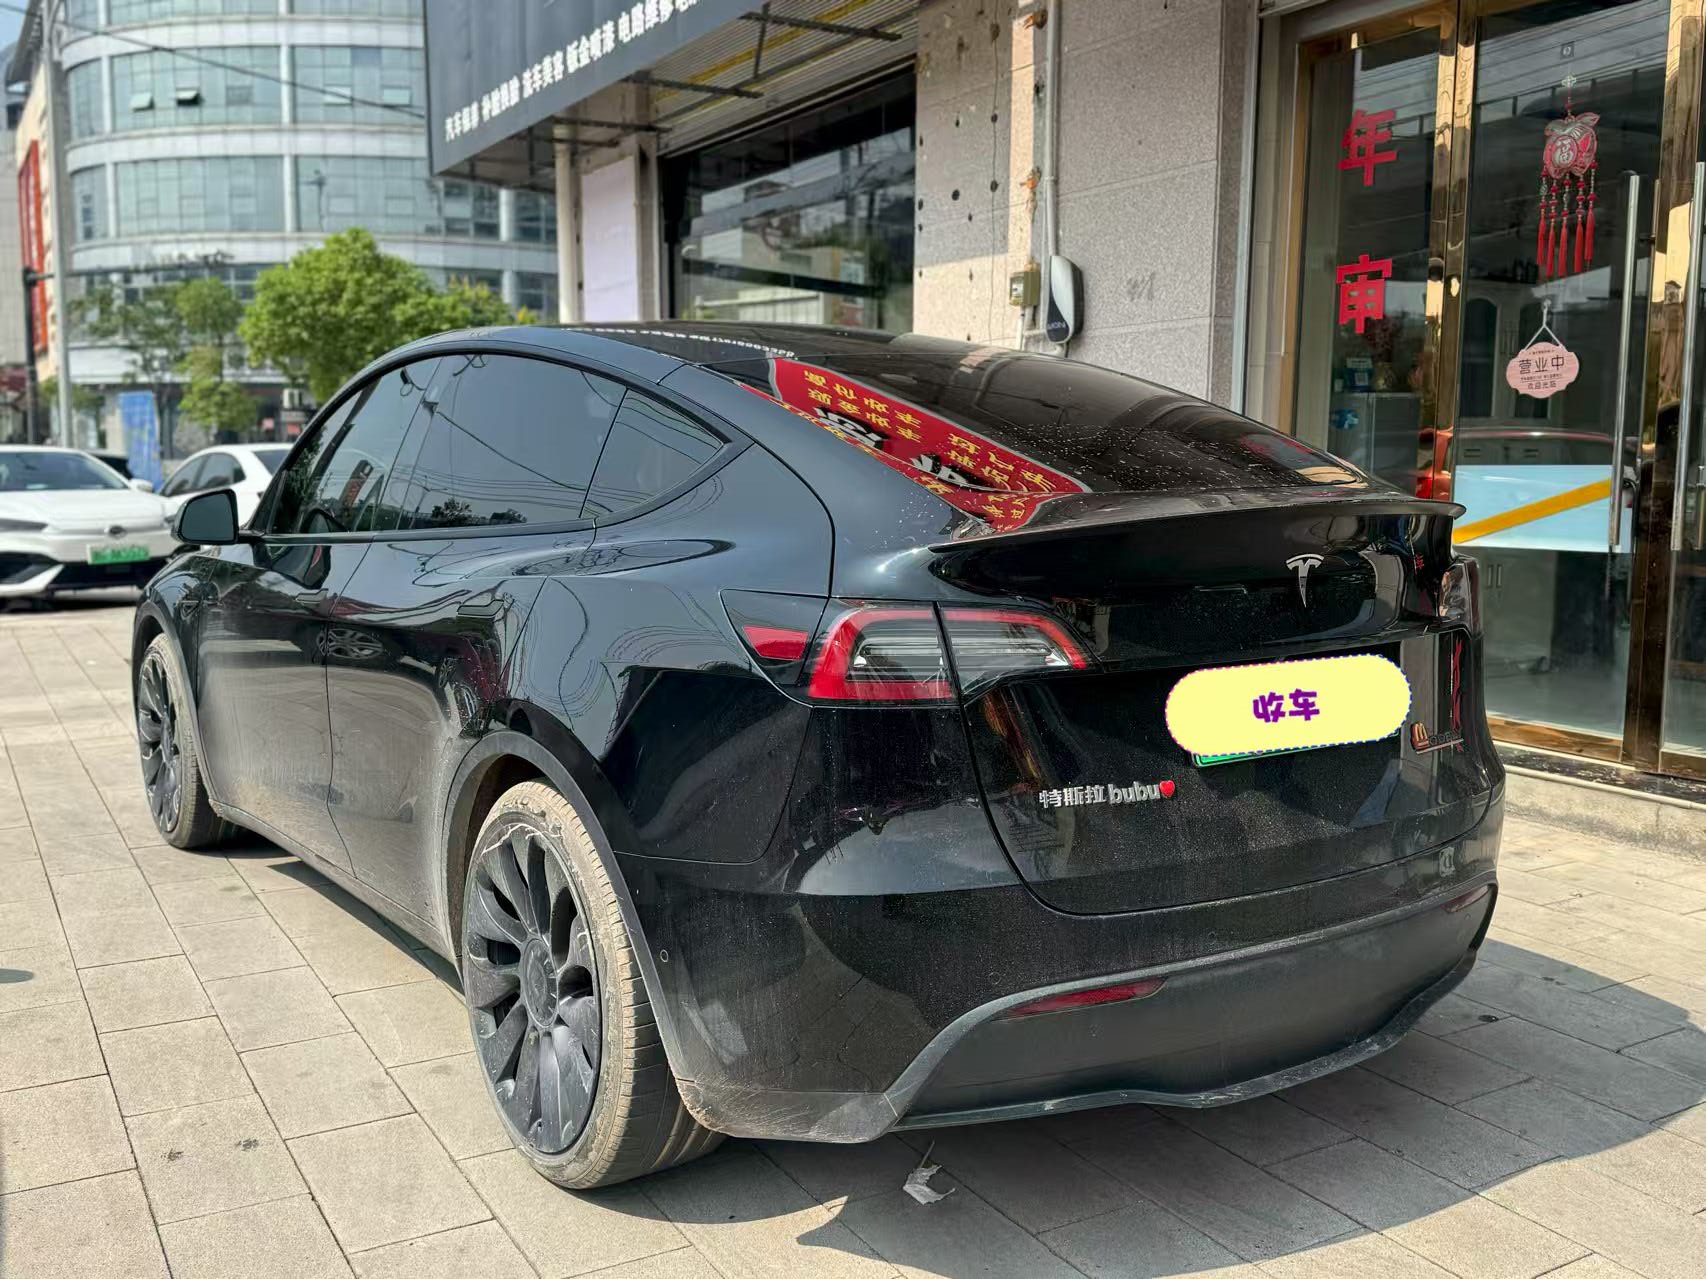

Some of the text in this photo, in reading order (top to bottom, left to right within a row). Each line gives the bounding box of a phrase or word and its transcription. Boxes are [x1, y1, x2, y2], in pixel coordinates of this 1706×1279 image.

[1336, 109, 1397, 334] 年审
[1519, 355, 1565, 375] 营业中
[1039, 782, 1160, 808] 特斯拉 bubu
